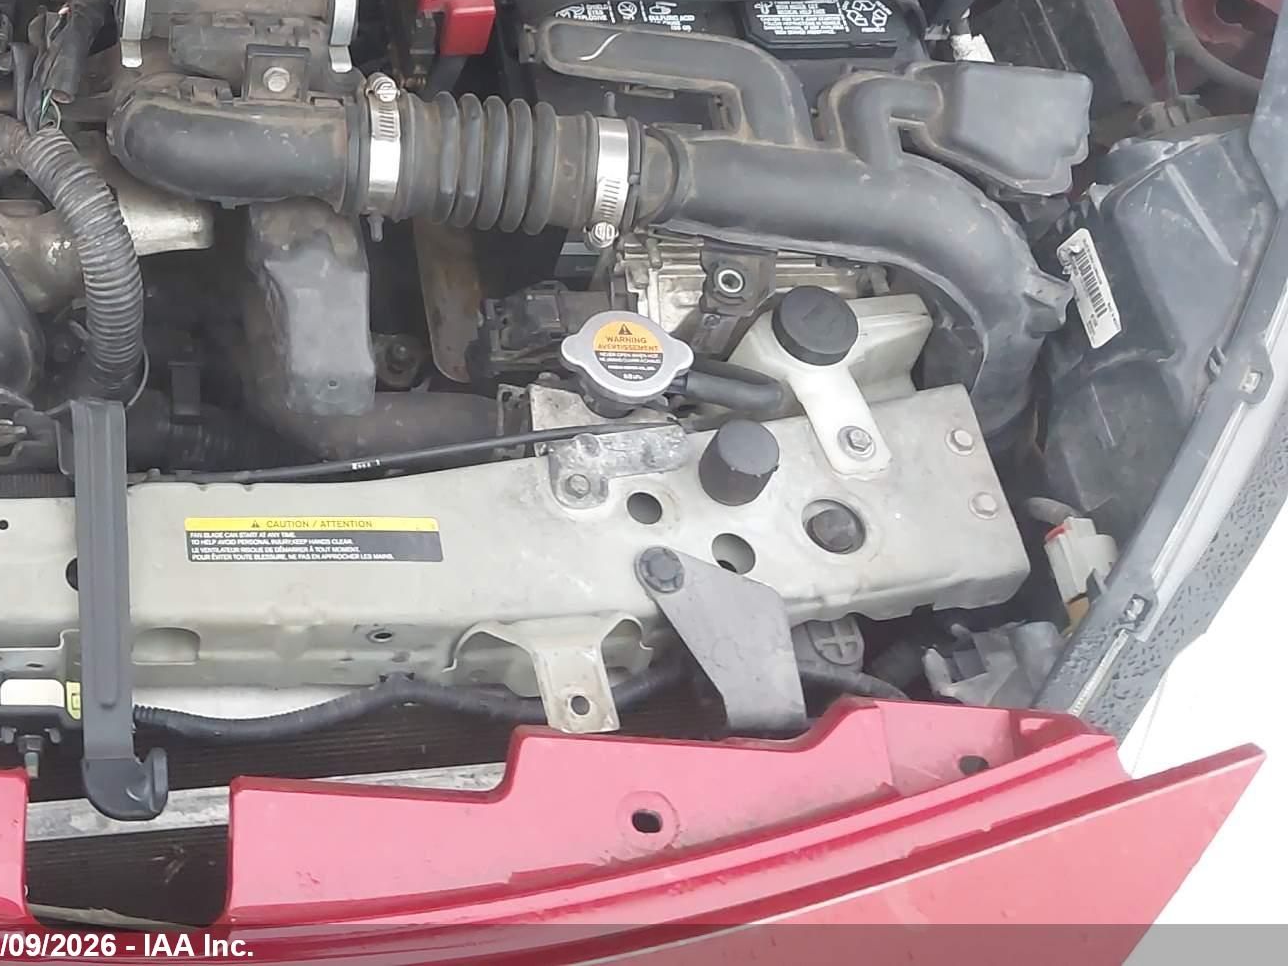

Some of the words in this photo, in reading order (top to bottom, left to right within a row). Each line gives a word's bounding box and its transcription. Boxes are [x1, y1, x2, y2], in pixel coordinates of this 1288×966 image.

[606, 336, 647, 344] WARNING
[266, 520, 309, 528] CAUTION
[312, 520, 317, 528] /
[320, 520, 373, 528] ATTENTION
